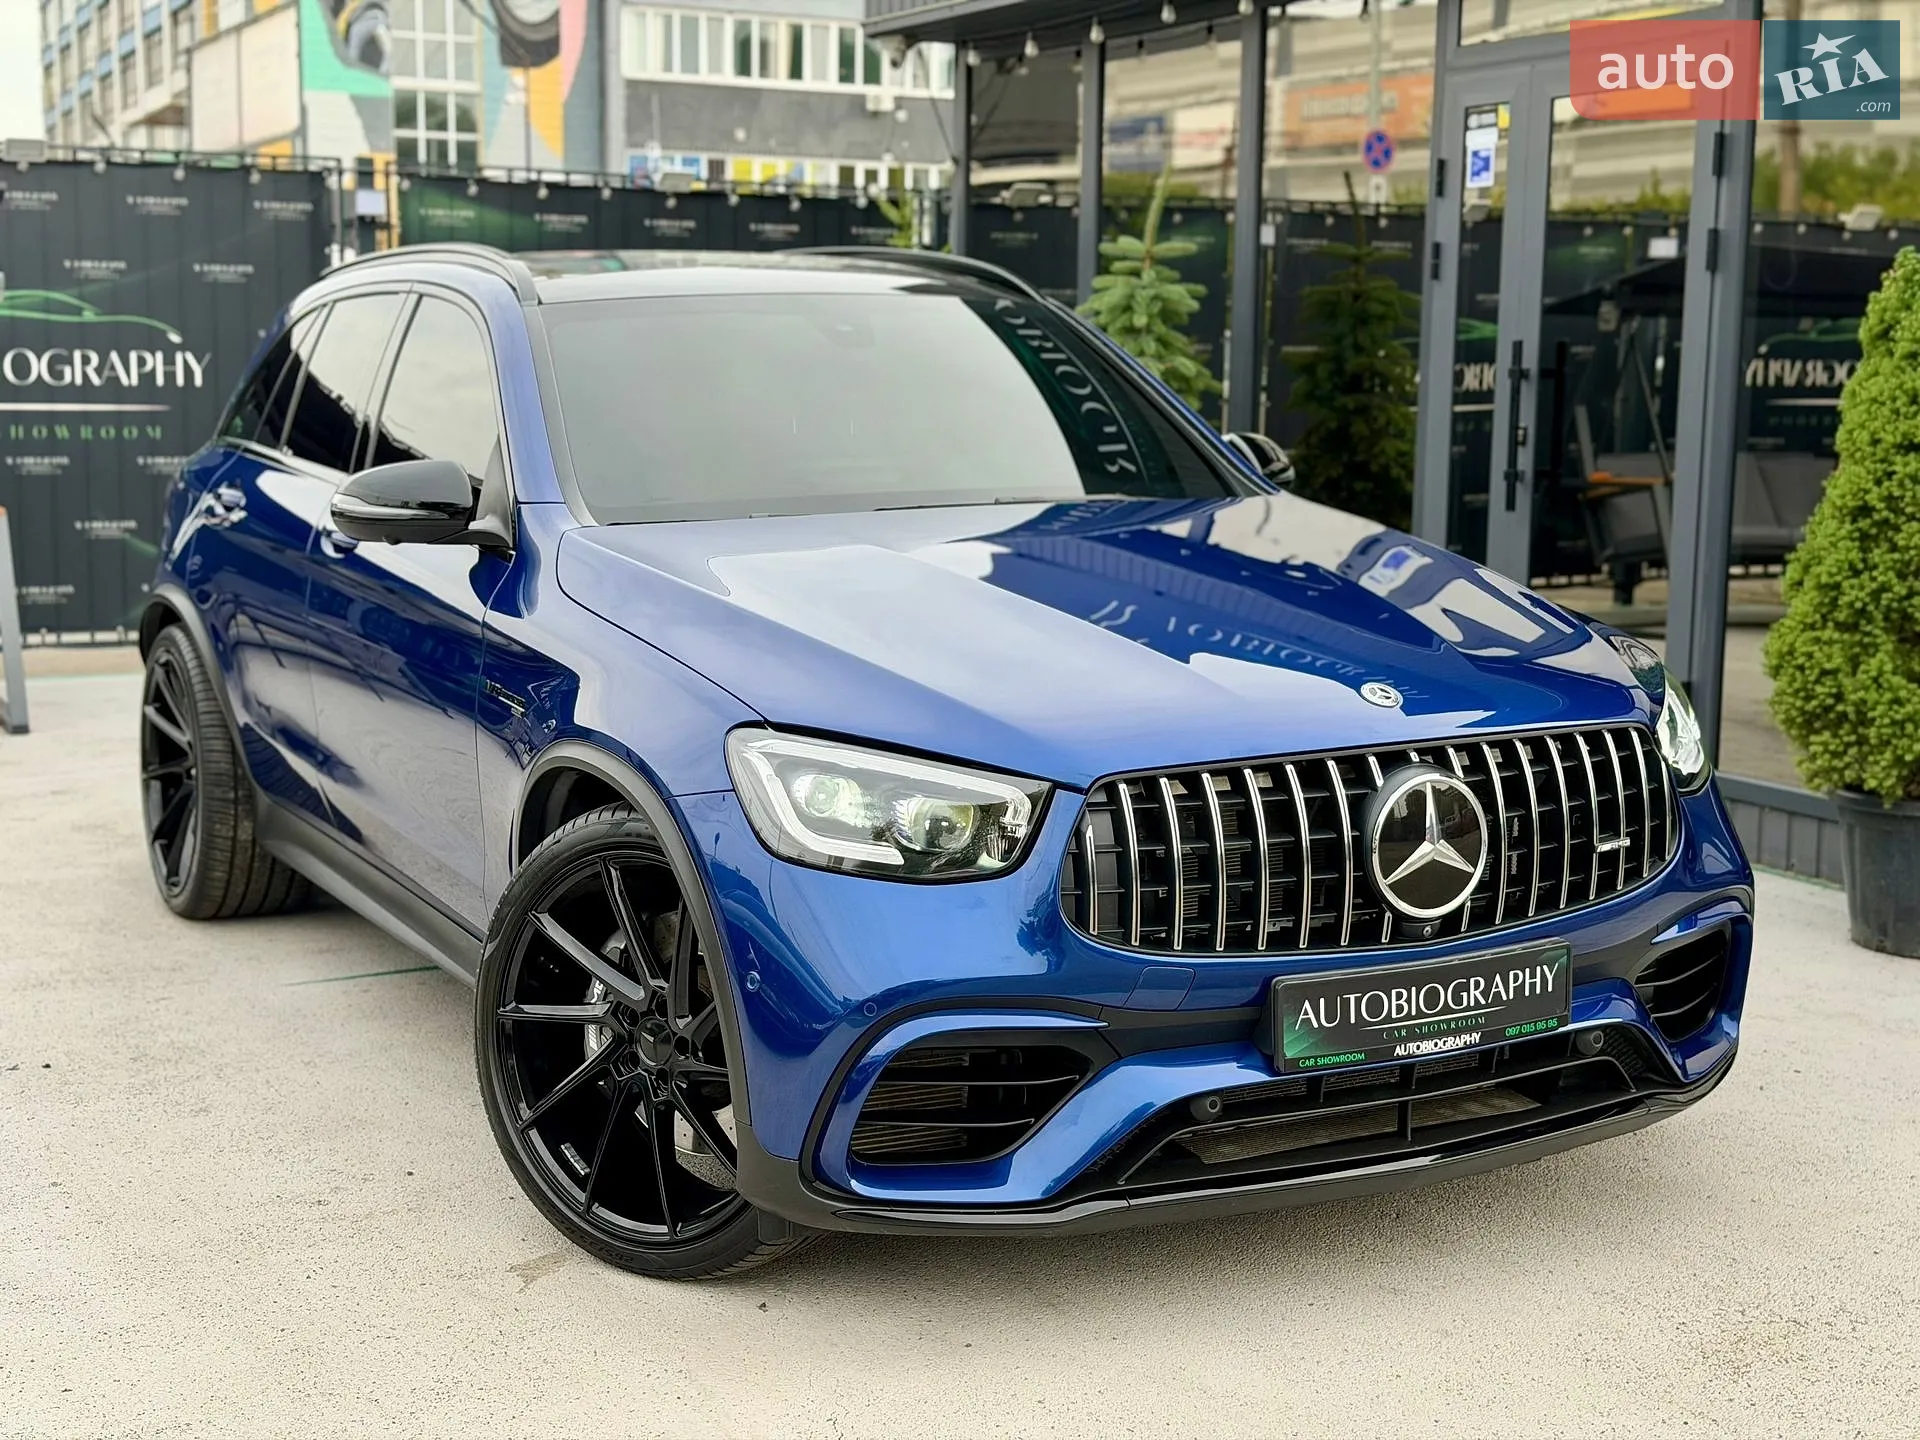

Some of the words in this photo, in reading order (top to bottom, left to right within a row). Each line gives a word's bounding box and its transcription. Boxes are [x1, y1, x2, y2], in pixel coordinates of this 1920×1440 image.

[2, 347, 212, 388] OGRAPHY
[1294, 963, 1559, 1031] AUTOBIOGRAPHY
[1383, 1028, 1407, 1039] CAR
[1414, 1016, 1486, 1035] SHOWROOM
[1393, 1032, 1482, 1057] AUTOBIOGRAPHY
[1299, 1058, 1315, 1067] CAR
[1316, 1053, 1365, 1066] SHOWROOM
